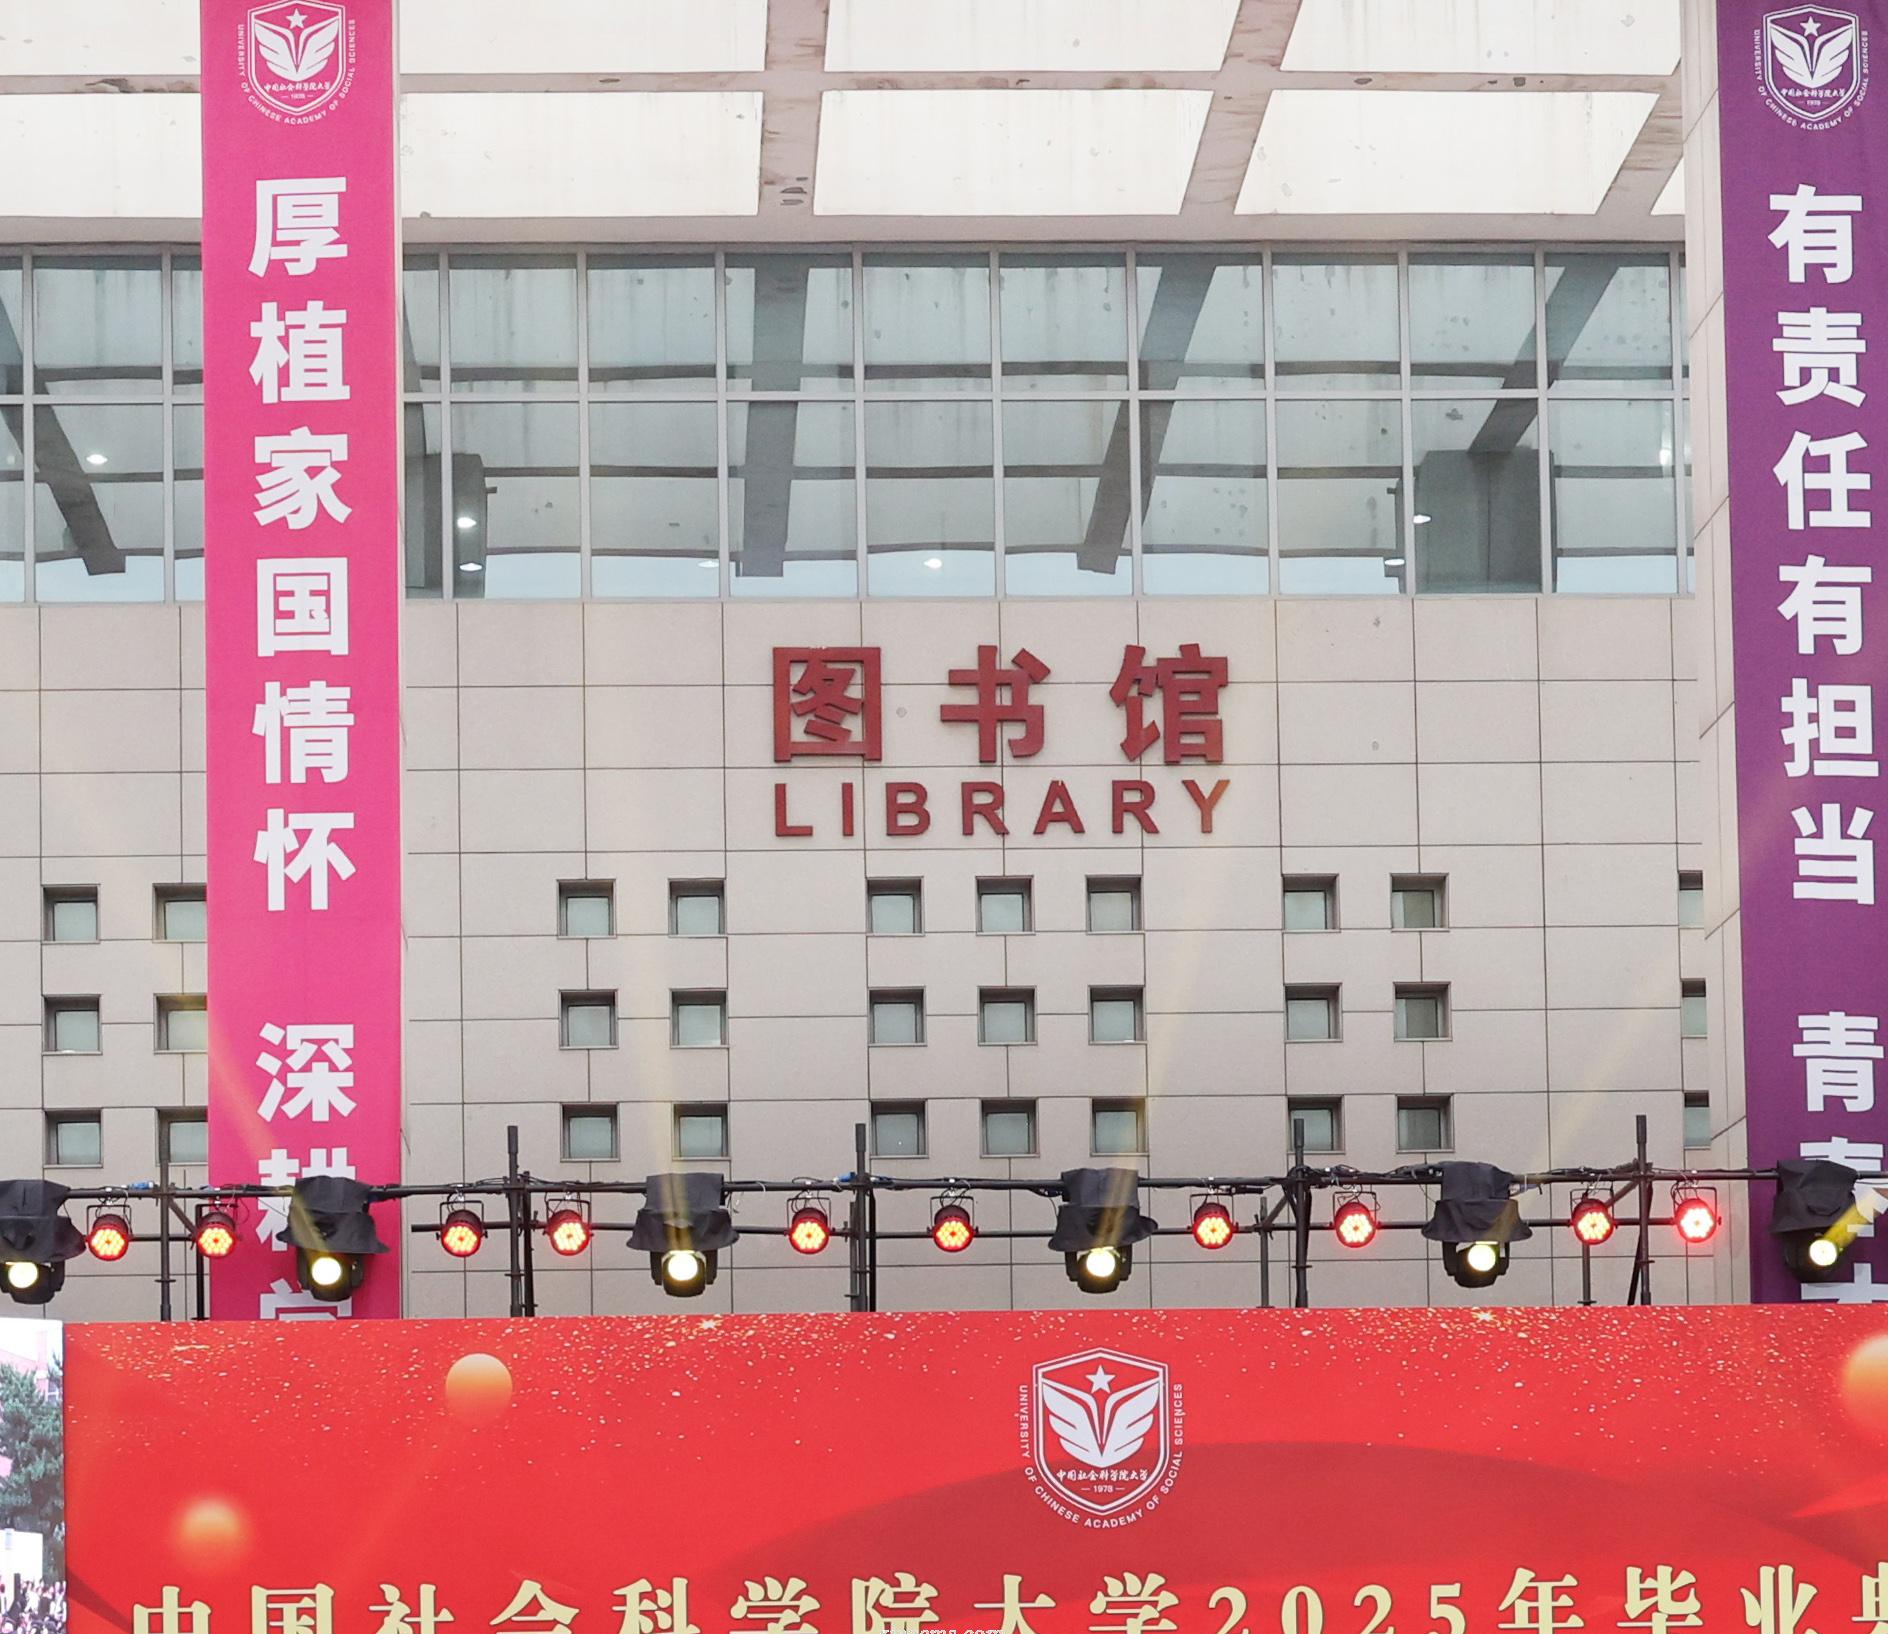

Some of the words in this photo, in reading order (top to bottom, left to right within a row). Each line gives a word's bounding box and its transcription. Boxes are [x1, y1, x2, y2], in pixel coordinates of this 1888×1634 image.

[248, 177, 356, 912] 厚植家国情怀
[1768, 184, 1879, 906] 有责任有担当
[772, 644, 1229, 765] 图书馆
[774, 779, 1231, 837] LIBRARY
[1019, 1385, 1031, 1458] UNIVERSITY
[1173, 1383, 1184, 1446] SCIENCES
[1024, 1466, 1037, 1483] OF
[1160, 1451, 1183, 1494] SOCIAL
[1034, 1485, 1080, 1524] CHINESE
[1084, 1510, 1143, 1529] ACADEMY
[1146, 1494, 1160, 1511] OF
